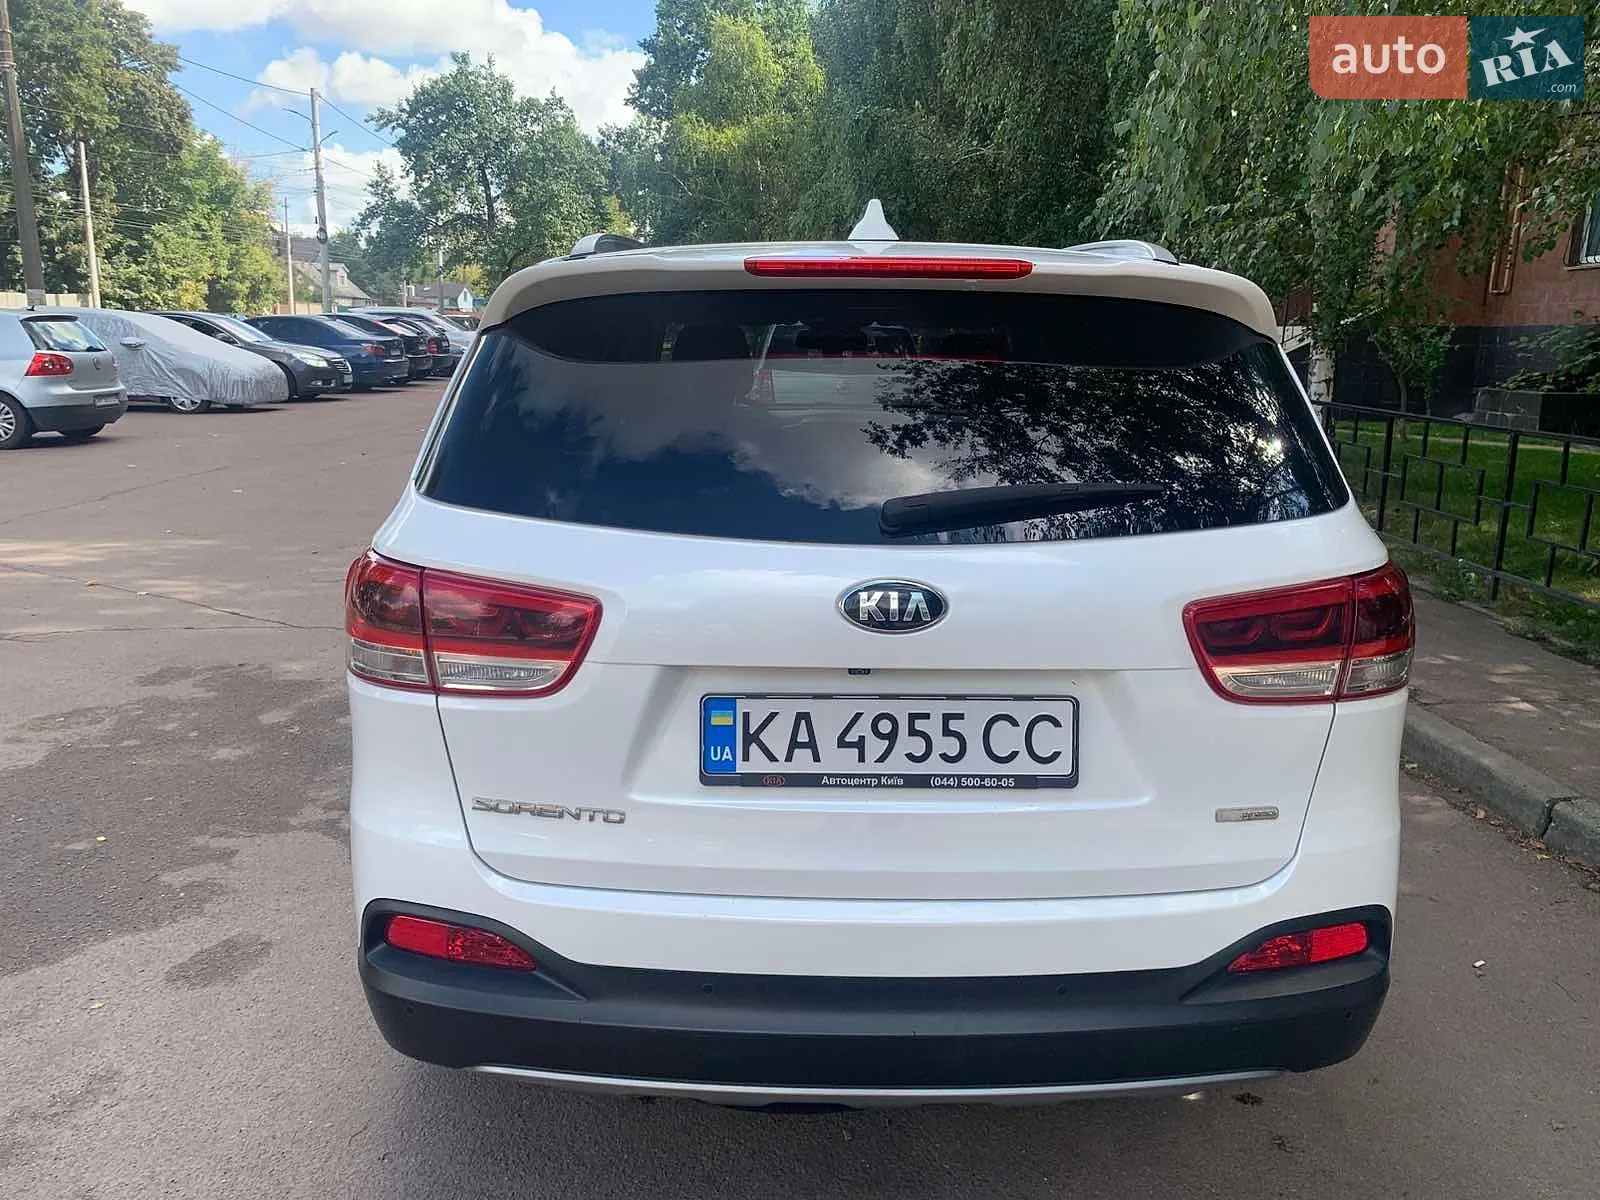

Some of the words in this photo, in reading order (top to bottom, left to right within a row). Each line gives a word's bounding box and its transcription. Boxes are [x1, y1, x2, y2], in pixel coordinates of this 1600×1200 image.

[741, 711, 821, 763] KA
[836, 711, 967, 764] 4955
[982, 713, 1063, 765] CC
[710, 745, 733, 761] UA
[821, 775, 878, 787] Автоцентр
[880, 775, 904, 786] Київ
[930, 776, 958, 787] (044)
[472, 797, 625, 824] SORENTO
